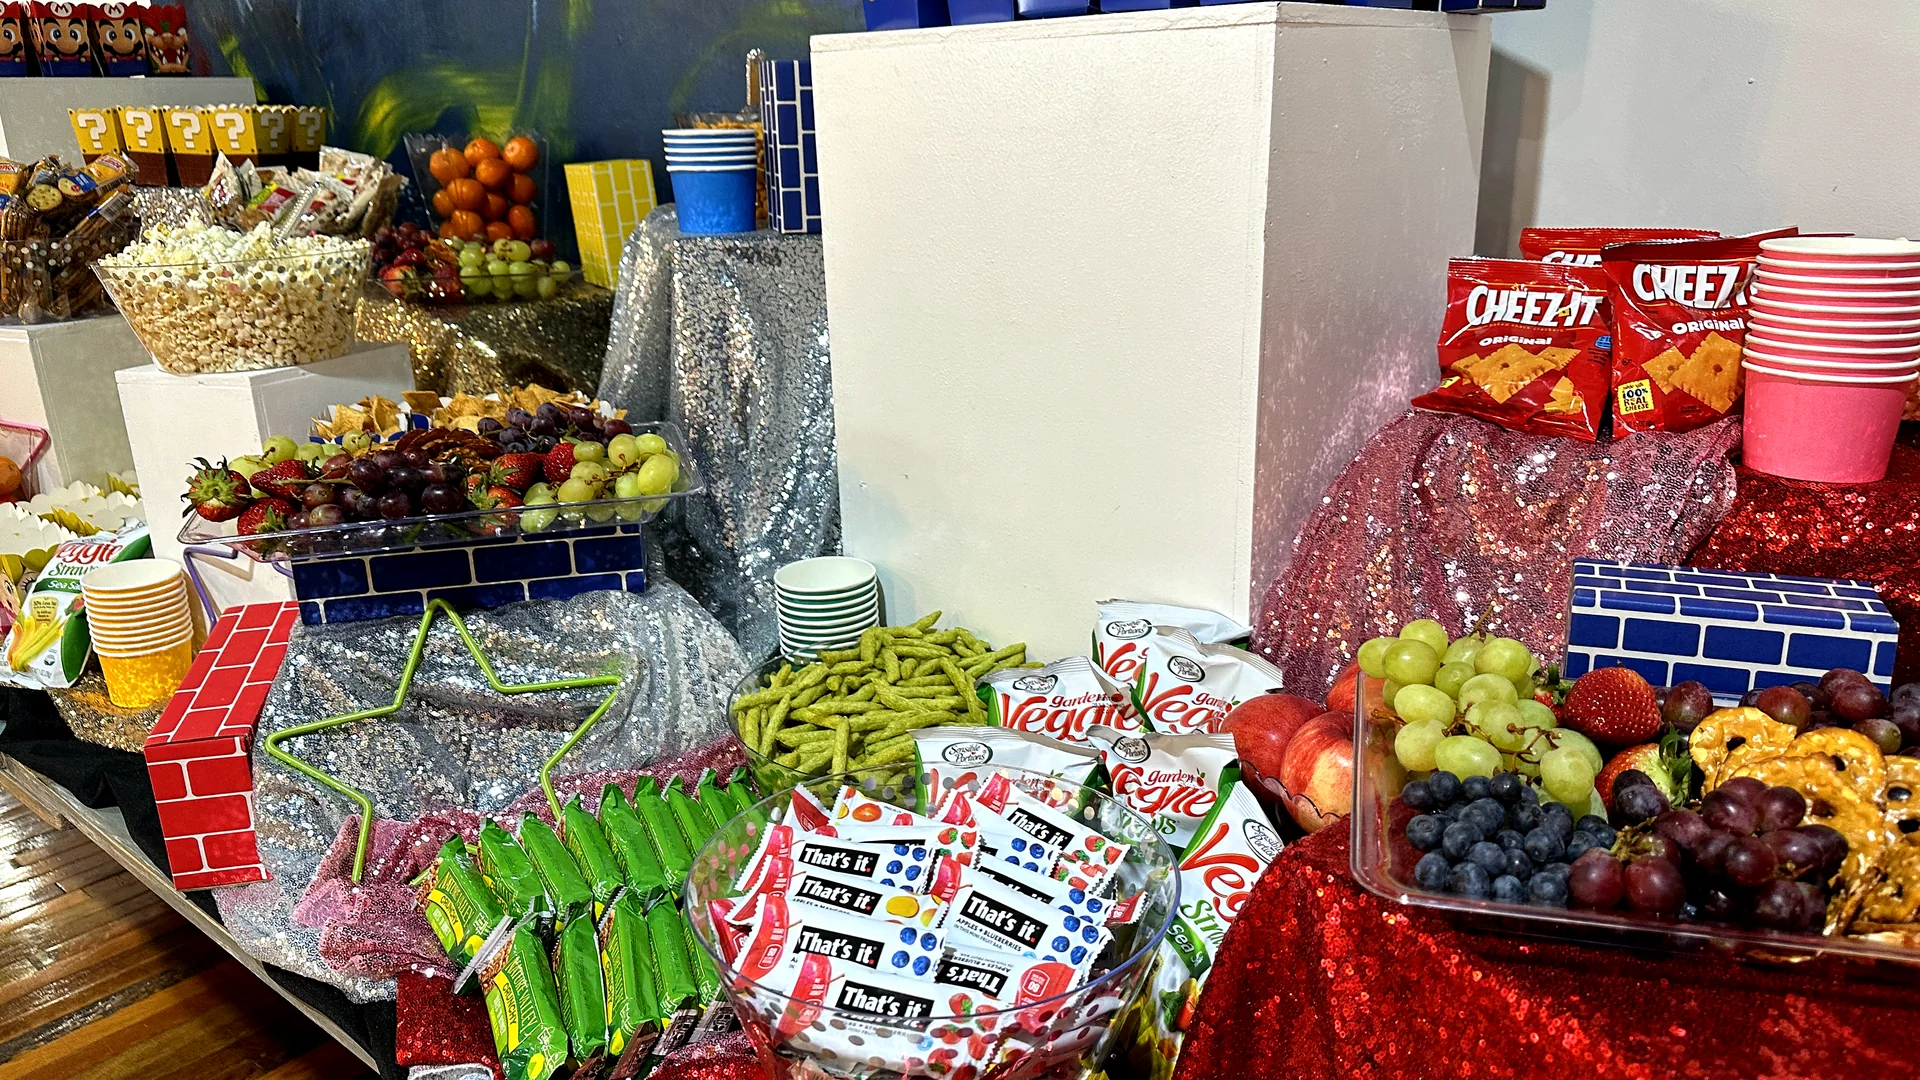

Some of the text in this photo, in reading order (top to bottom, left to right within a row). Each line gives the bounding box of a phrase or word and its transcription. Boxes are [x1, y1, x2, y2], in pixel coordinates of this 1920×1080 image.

[1010, 811, 1050, 840] That's
[803, 848, 851, 869] That's
[802, 880, 852, 904] That's
[967, 896, 1017, 932] That's
[800, 931, 853, 959] That's
[956, 918, 979, 932] APPLES
[983, 929, 1022, 952] BLUEBERRIES
[947, 966, 1000, 993] That's
[502, 982, 517, 1025] CRUNCHY
[842, 986, 901, 1016] That's
